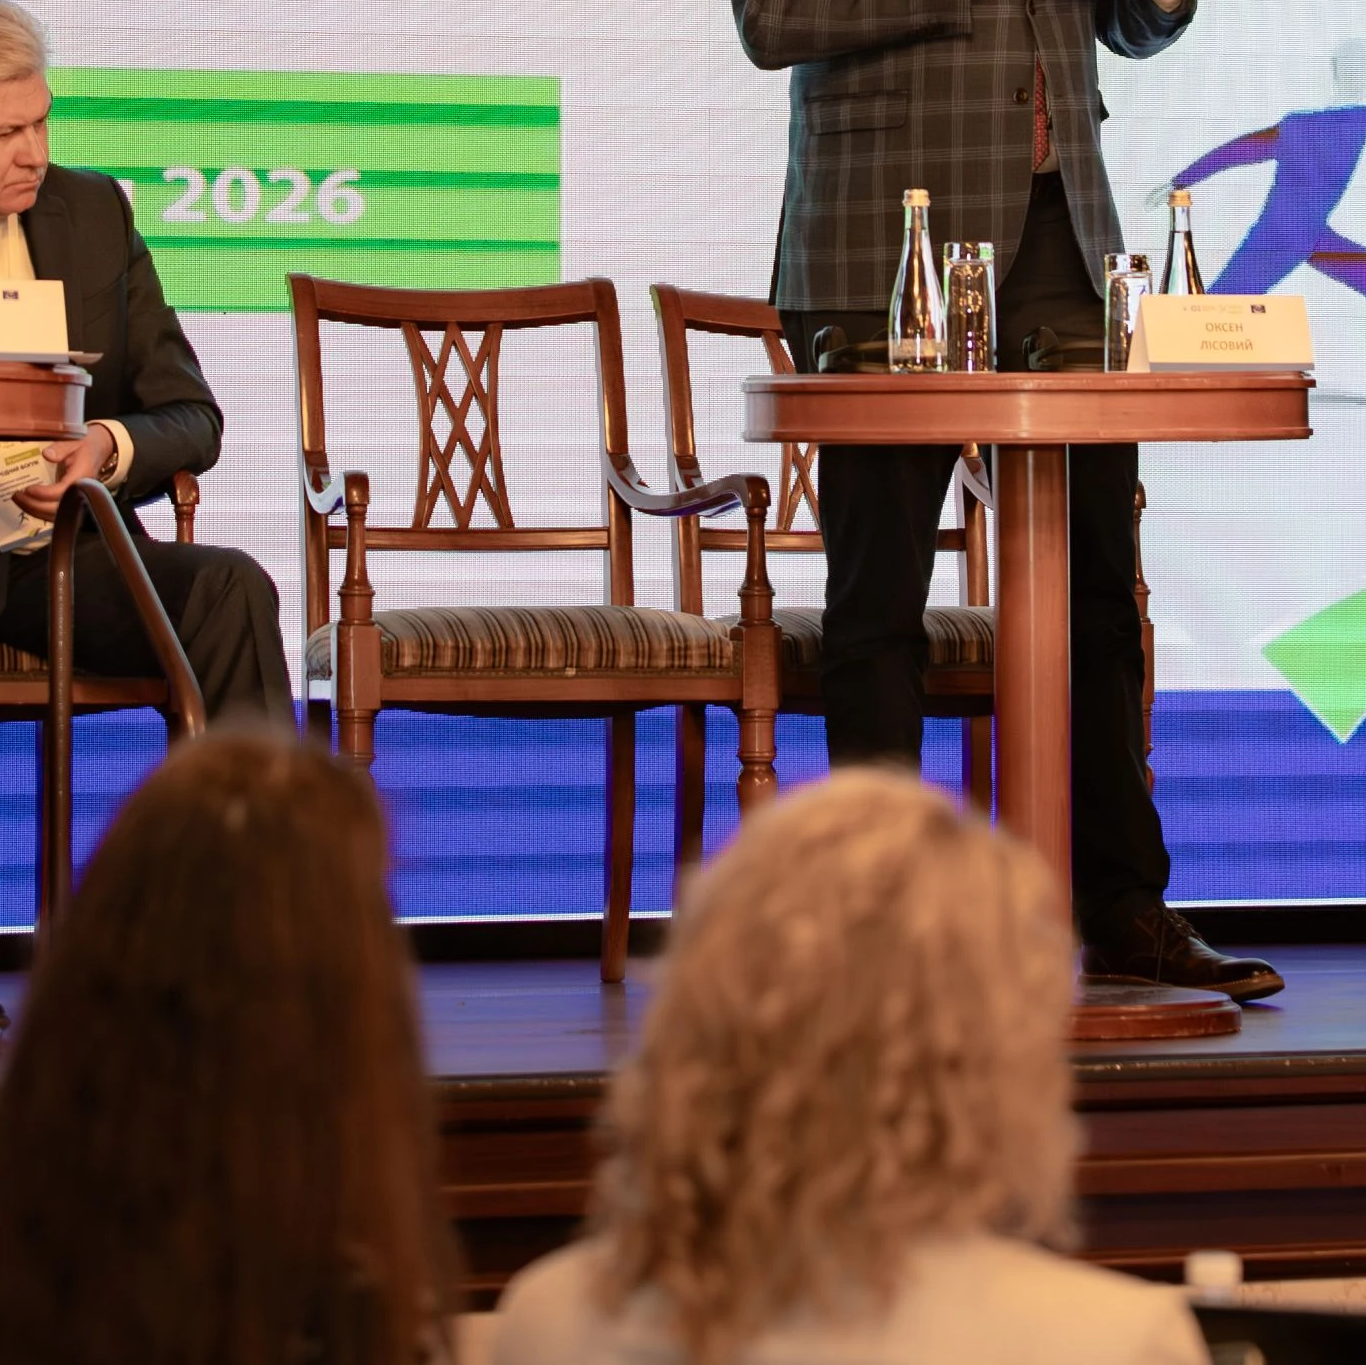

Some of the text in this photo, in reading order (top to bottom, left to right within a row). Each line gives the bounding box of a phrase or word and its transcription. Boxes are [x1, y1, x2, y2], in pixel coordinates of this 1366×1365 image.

[161, 164, 366, 224] 2026
[1205, 322, 1244, 333] ОКСЕН
[1199, 338, 1254, 351] ЛІСОВИЙ
